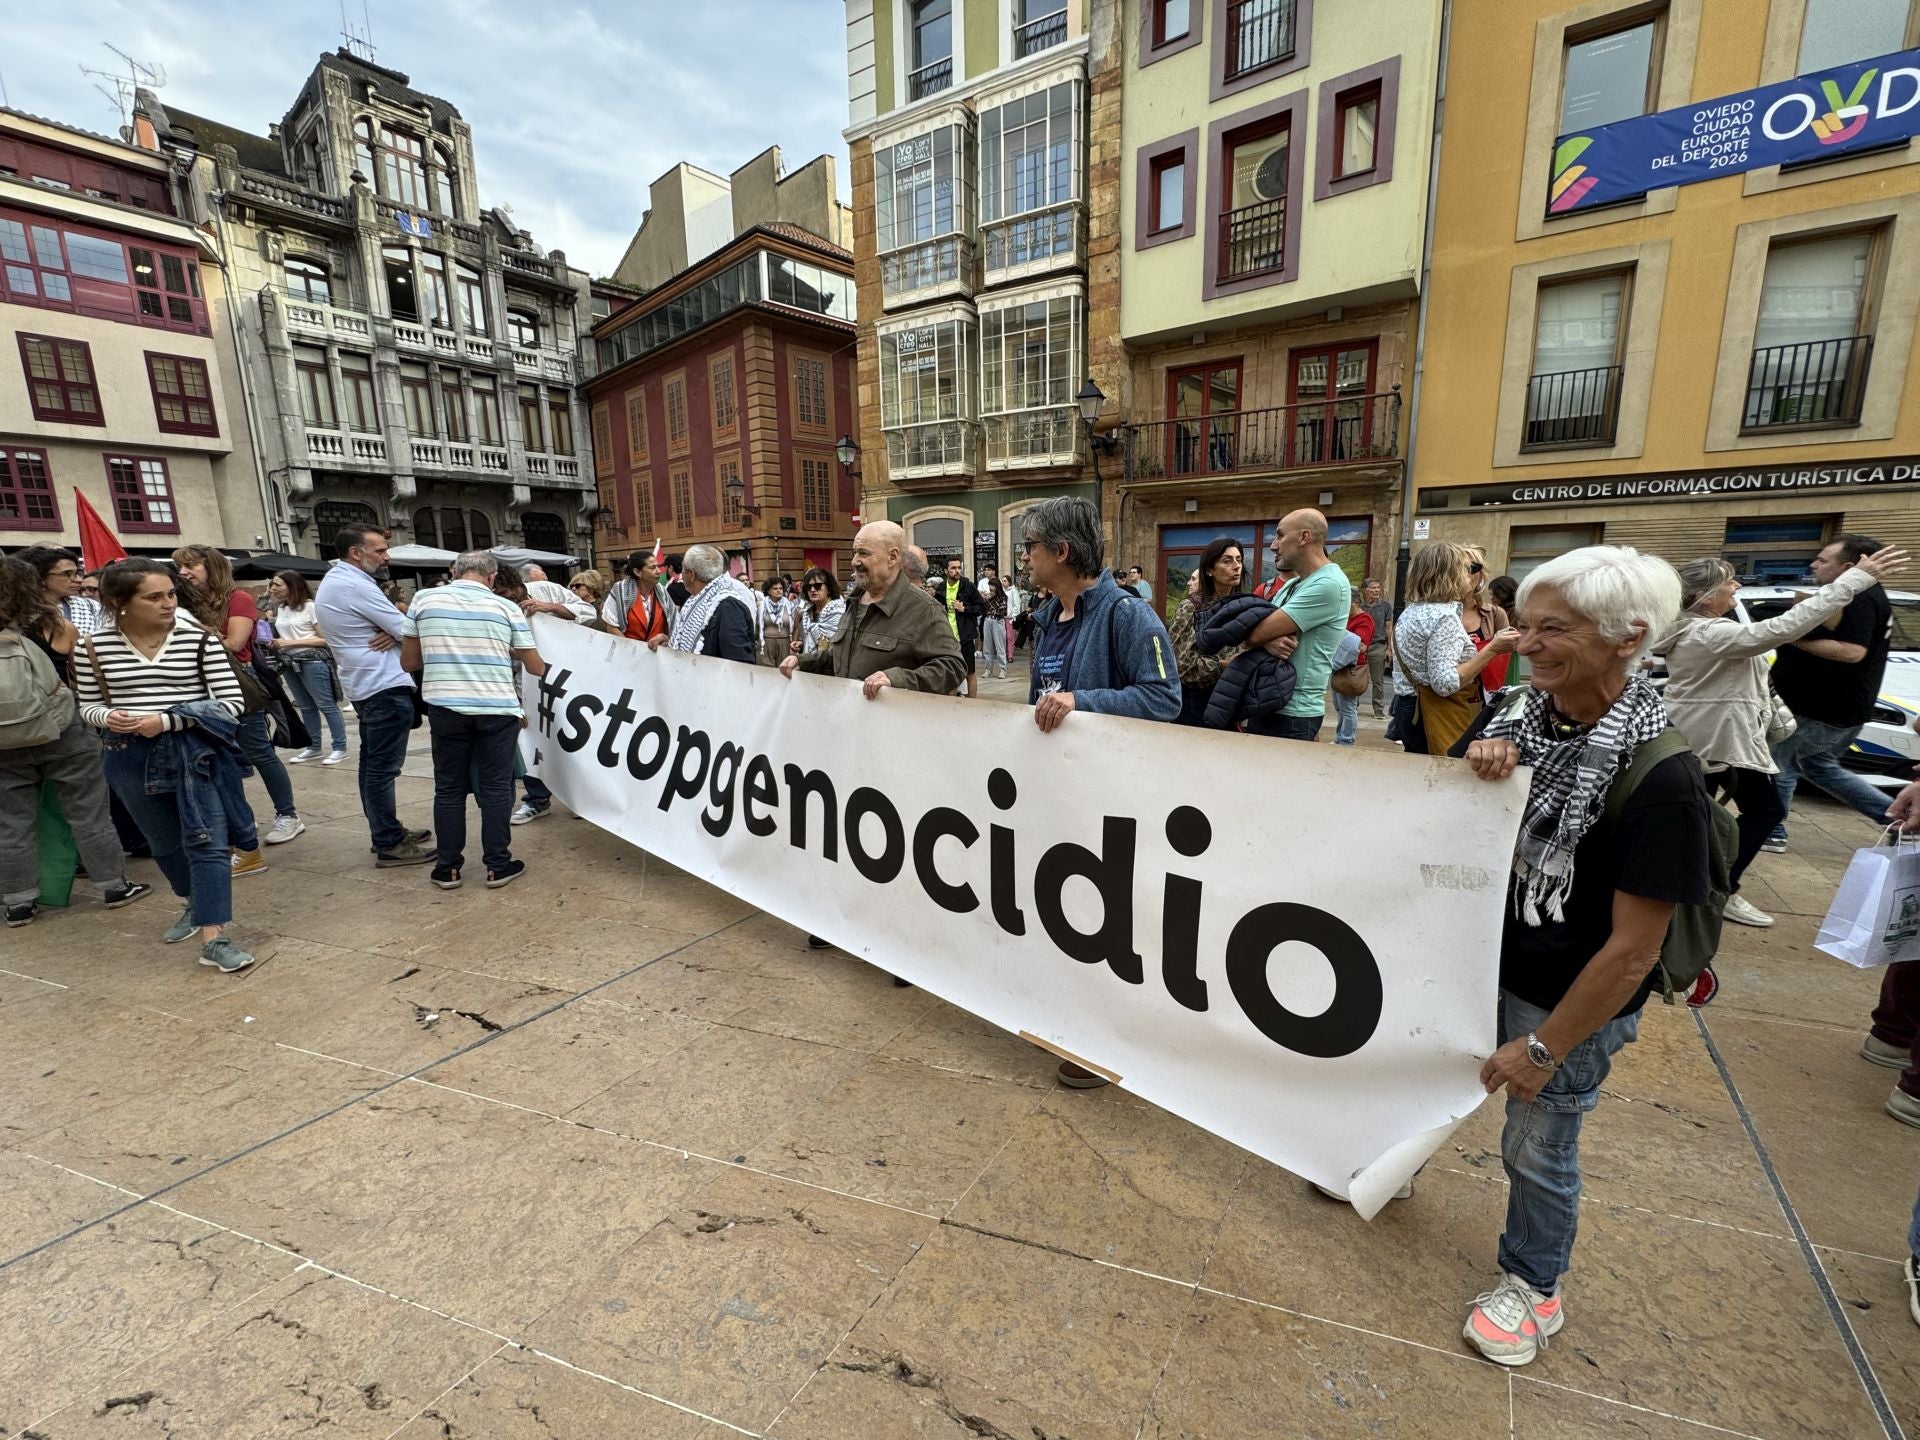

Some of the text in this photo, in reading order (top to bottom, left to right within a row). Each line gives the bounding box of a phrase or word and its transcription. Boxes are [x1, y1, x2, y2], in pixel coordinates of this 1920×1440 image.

[1693, 112, 1753, 135] CIUDAD
[1694, 99, 1755, 123] OVIEDO
[1681, 125, 1751, 151] EUROPEA
[1652, 138, 1750, 170] DEL DEPORTE
[1708, 151, 1748, 170] 2026
[1512, 484, 1583, 501] CENTRO
[1587, 483, 1613, 497] DE
[1617, 472, 1763, 495] INFORMACIÓN
[1767, 466, 1886, 487] TURÍSTICA
[538, 661, 1384, 1058] #stopgenocidio
